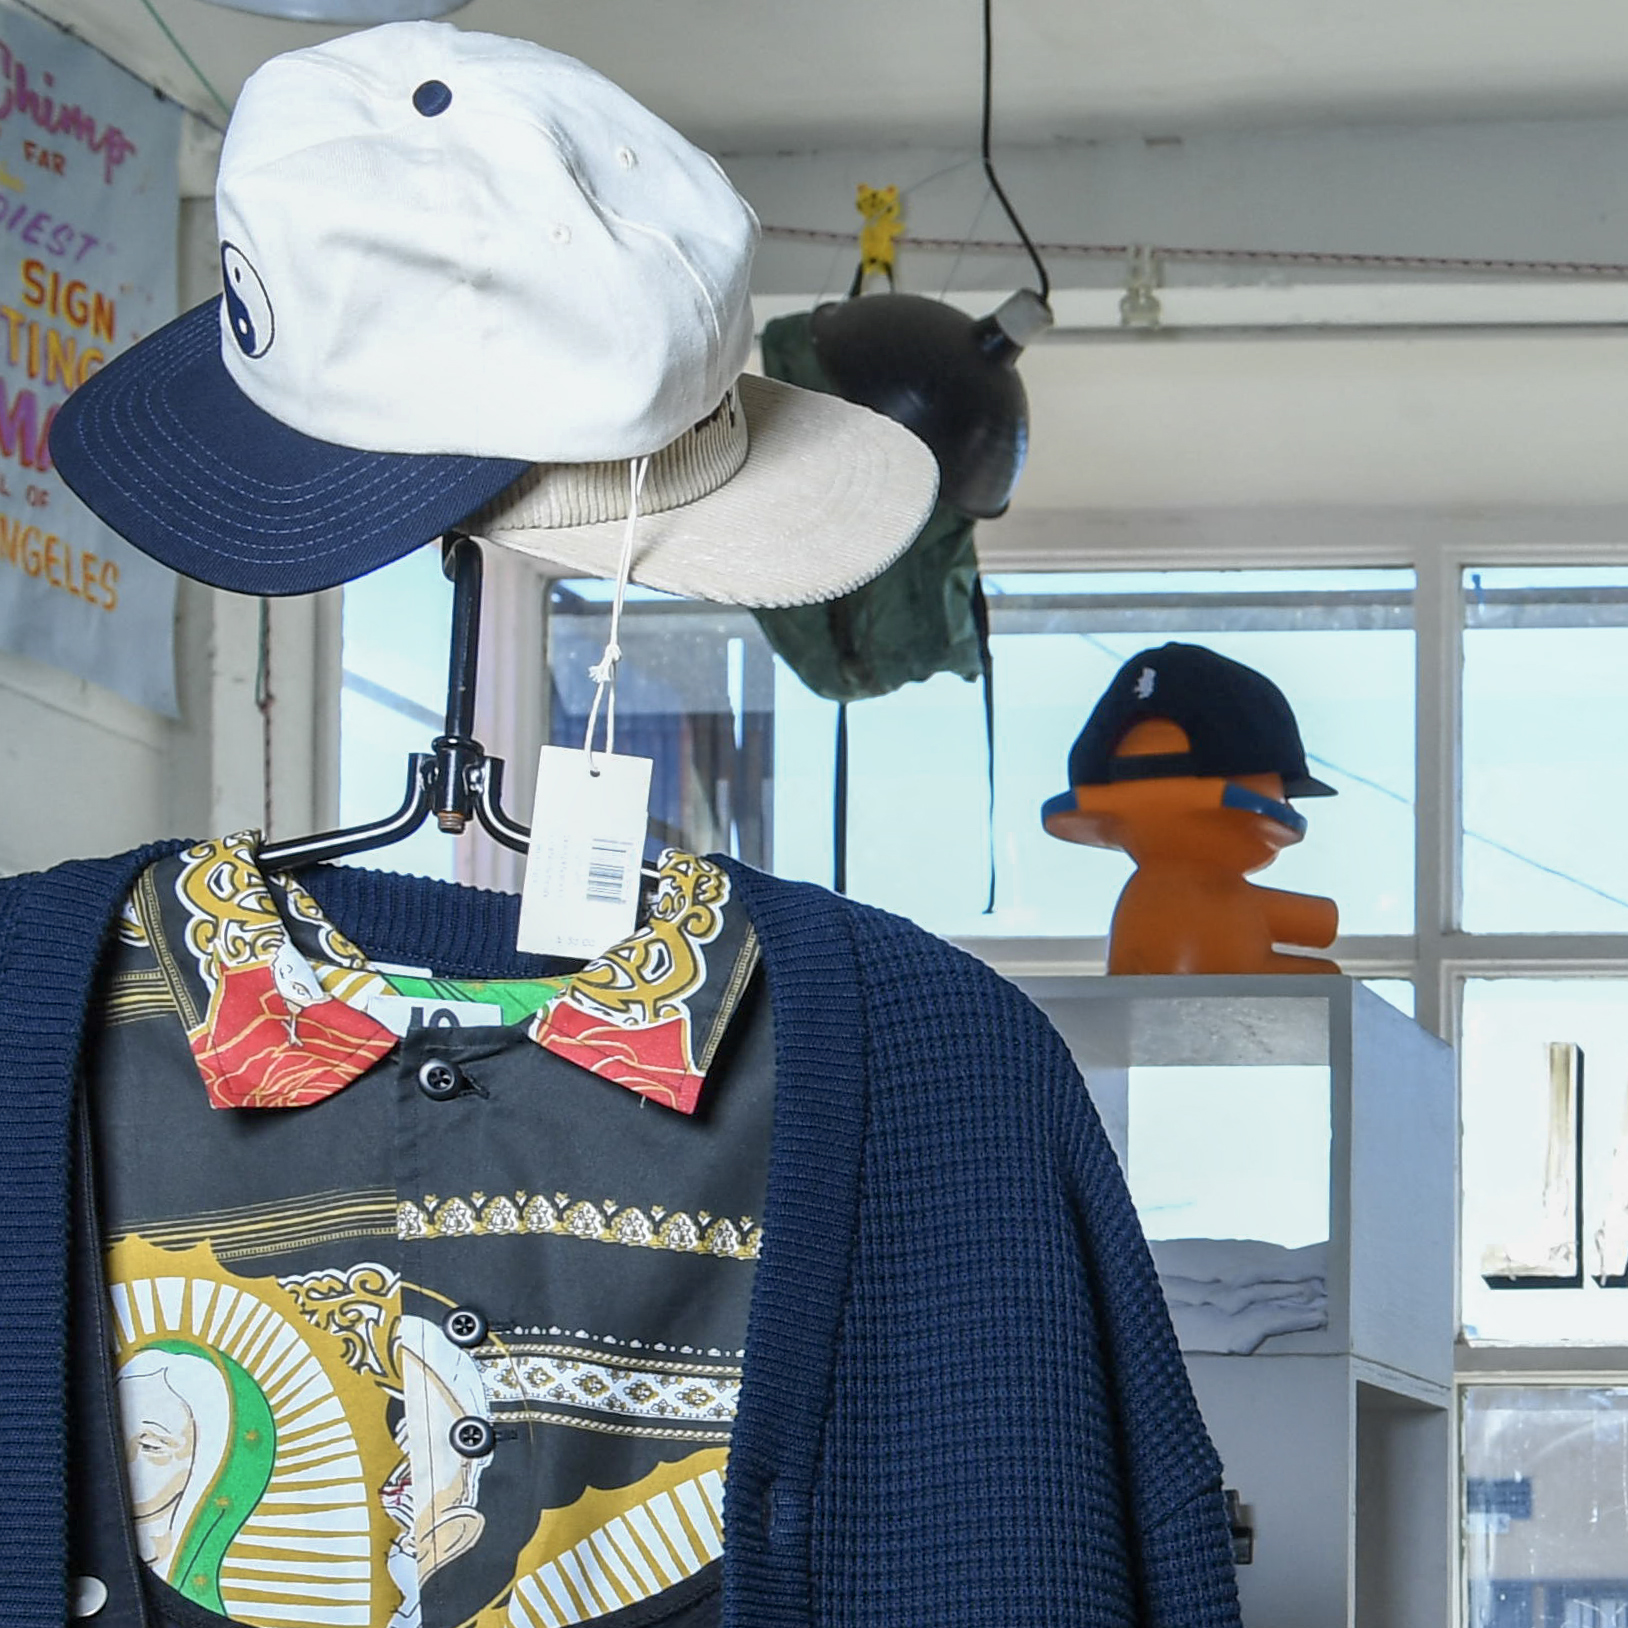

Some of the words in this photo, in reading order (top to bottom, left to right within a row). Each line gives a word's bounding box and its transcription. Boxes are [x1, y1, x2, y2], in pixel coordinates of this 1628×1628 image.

[23, 140, 67, 177] FAR
[0, 196, 99, 264] IEST
[21, 258, 116, 344] SIGN
